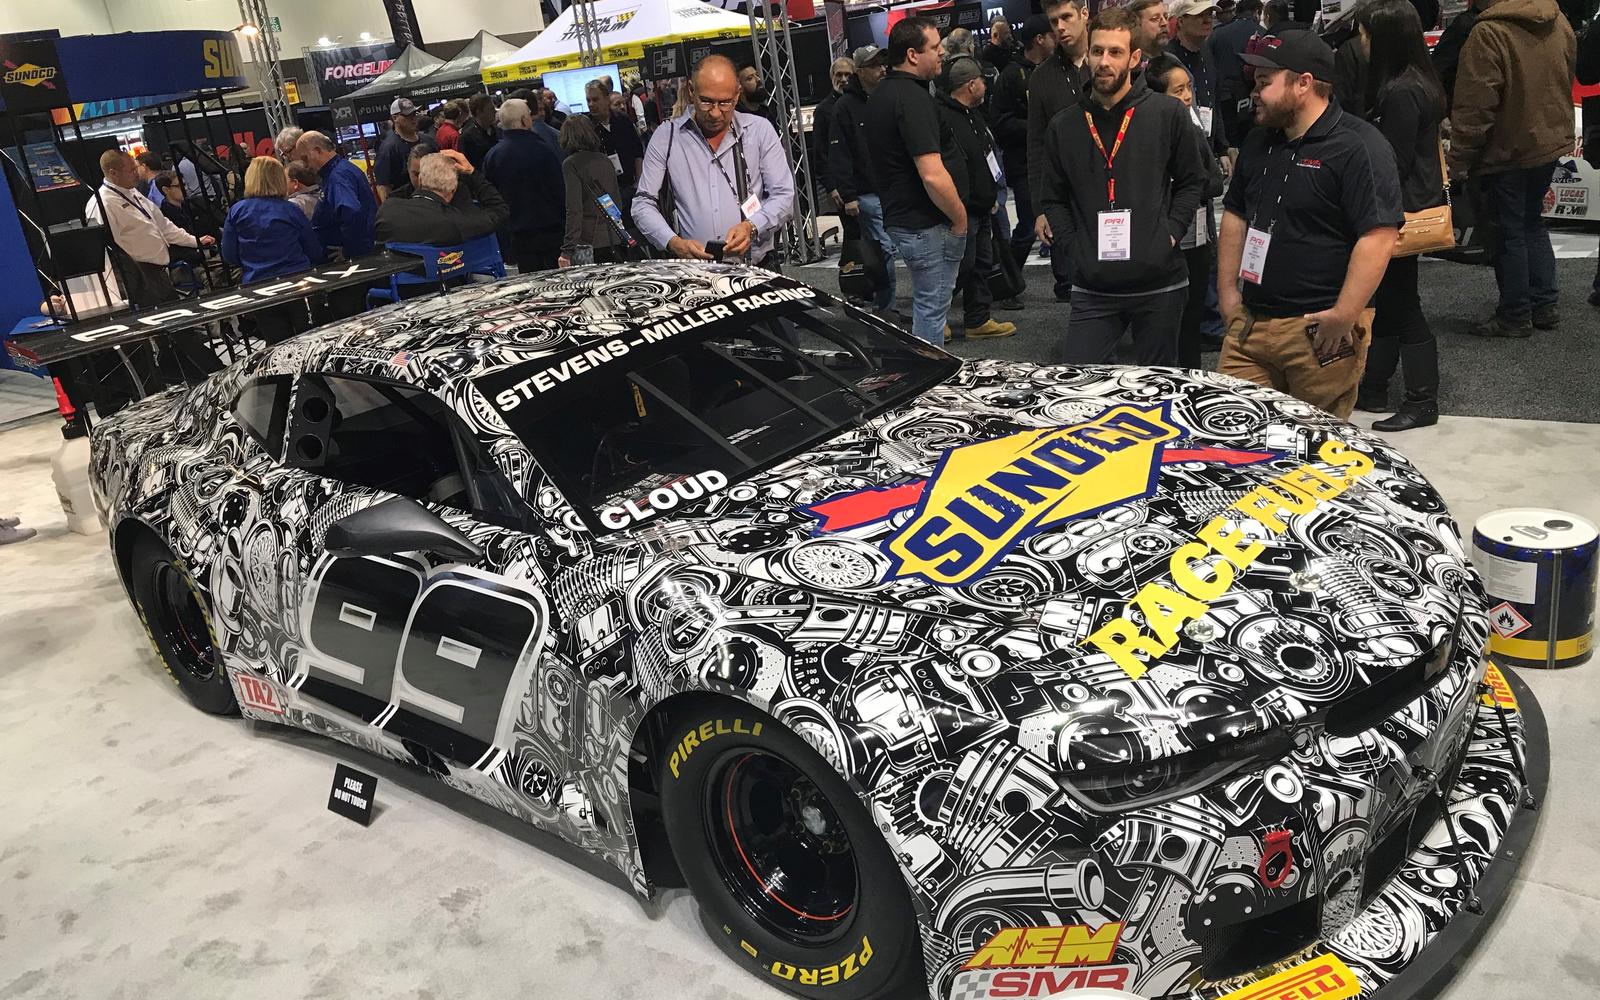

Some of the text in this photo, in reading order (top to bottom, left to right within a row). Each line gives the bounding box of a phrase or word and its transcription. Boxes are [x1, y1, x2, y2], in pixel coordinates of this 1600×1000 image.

[971, 23, 1024, 36] MATON
[4, 67, 55, 84] SUNOCO
[411, 81, 470, 97] TRACTION CONTROL
[331, 347, 395, 361] DEBBIE CLOUD
[495, 304, 730, 413] STEVENS-MILLER
[737, 285, 817, 313] RACING
[600, 470, 728, 530] CLOUD
[902, 419, 1167, 577] SUNOCO
[1252, 440, 1376, 534] FUELS
[1080, 517, 1266, 680] RACE
[240, 676, 277, 709] TA2
[668, 718, 764, 779] PIRELLI
[341, 791, 351, 803] NOT
[351, 795, 367, 810] TOUCH
[344, 777, 363, 793] PLEASE
[960, 921, 1126, 969] AEM
